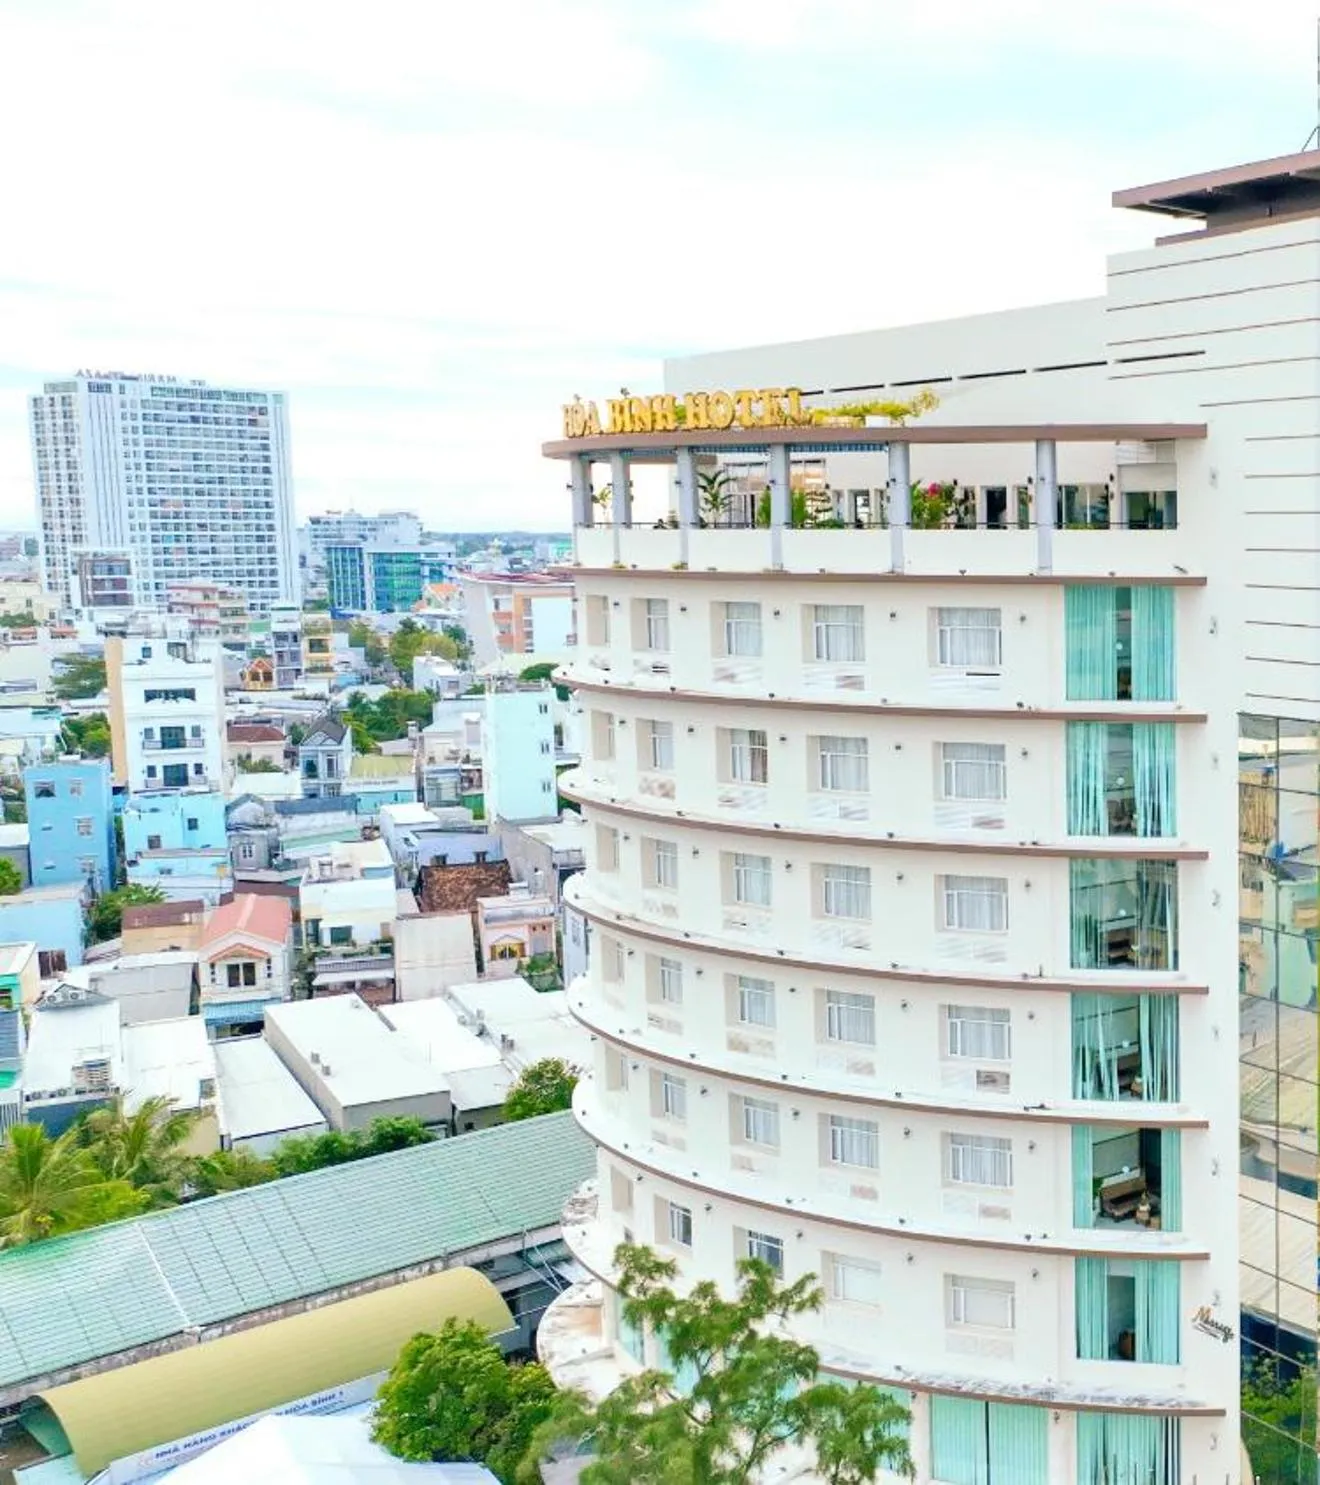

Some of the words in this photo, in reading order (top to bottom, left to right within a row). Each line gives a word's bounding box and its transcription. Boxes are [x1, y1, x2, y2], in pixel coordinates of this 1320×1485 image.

[562, 394, 604, 439] HÒA
[605, 387, 679, 434] BÌNH
[683, 387, 814, 431] HOTEL
